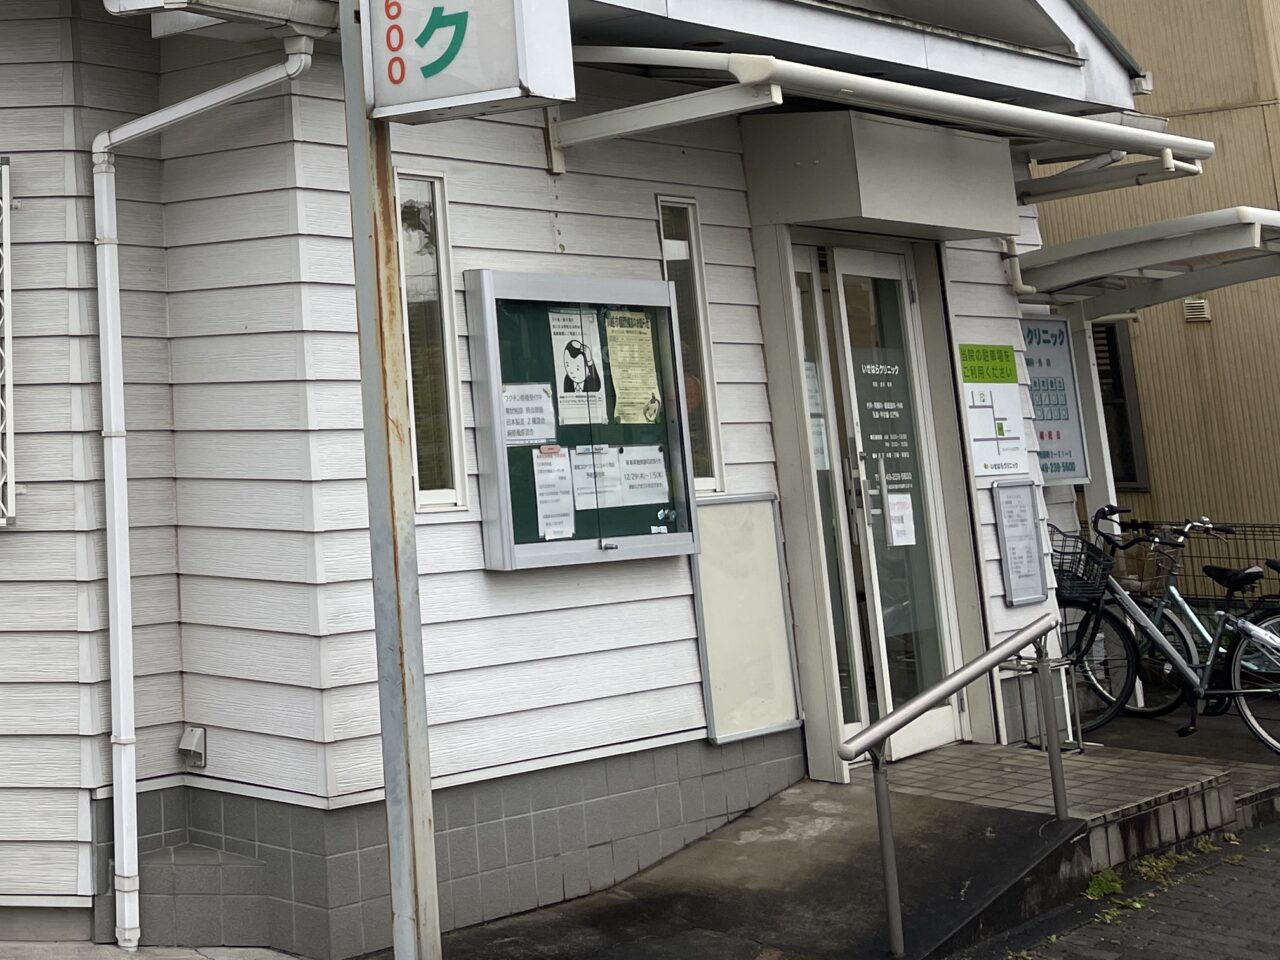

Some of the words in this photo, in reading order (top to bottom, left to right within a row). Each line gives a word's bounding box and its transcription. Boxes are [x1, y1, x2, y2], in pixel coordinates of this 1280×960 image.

[1023, 327, 1065, 346] クリニック
[963, 365, 1013, 379] ご利用ください
[1040, 461, 1076, 473] 49-239-5600
